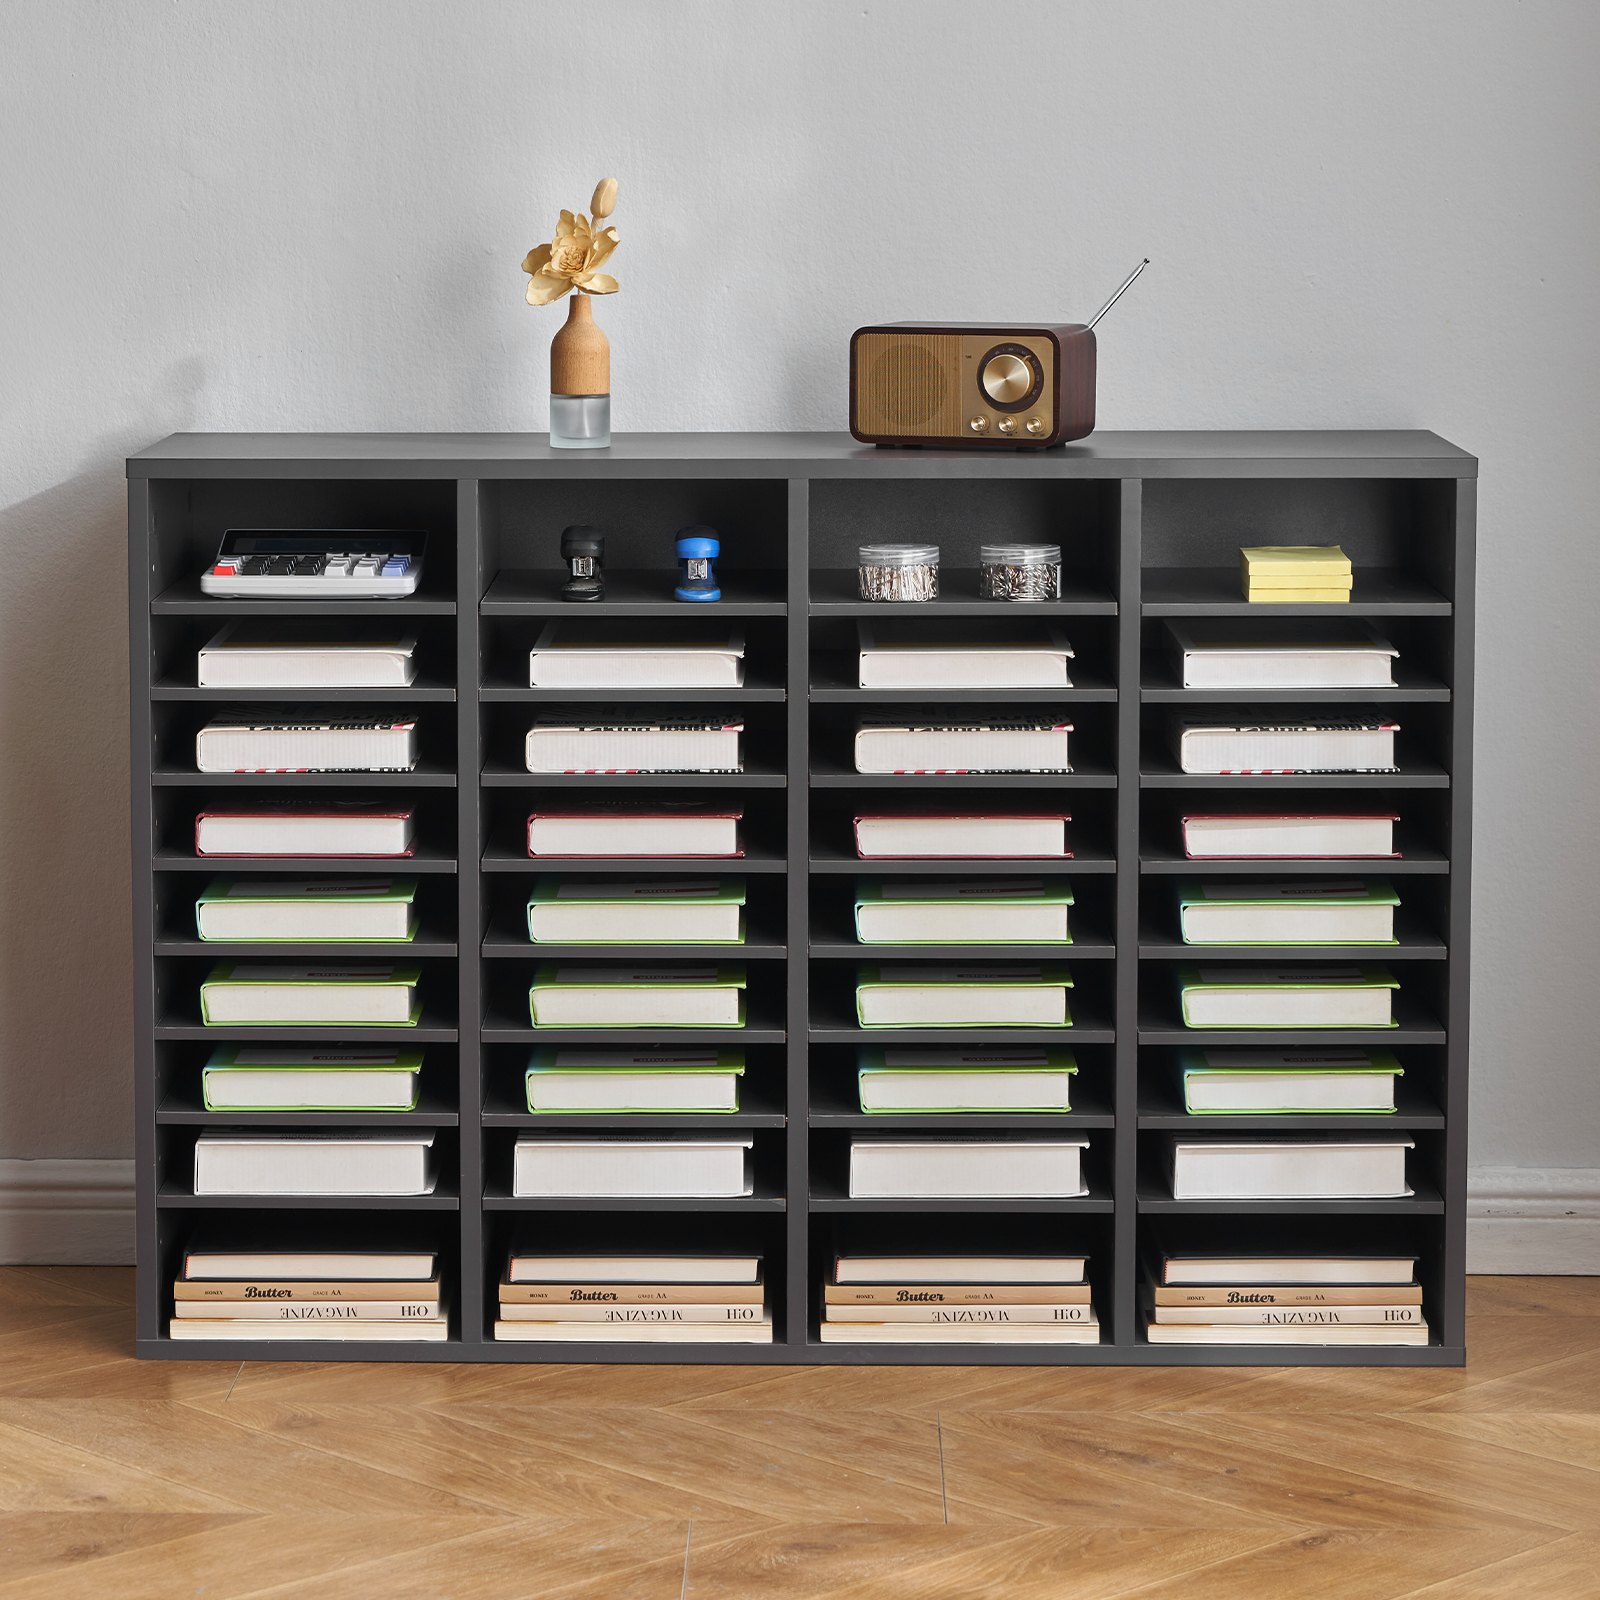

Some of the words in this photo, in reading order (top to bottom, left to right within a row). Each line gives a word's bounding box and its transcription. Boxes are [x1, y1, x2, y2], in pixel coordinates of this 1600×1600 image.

[244, 1286, 293, 1298] Butter
[569, 1289, 618, 1301] Butter
[896, 1289, 945, 1302] Butter
[1227, 1291, 1276, 1304] Butter
[280, 1306, 358, 1318] MAGAZINE
[605, 1309, 683, 1321] MAGAZINE
[931, 1310, 1010, 1322] MAGAZINE
[1262, 1311, 1341, 1323] MAGAZINE
